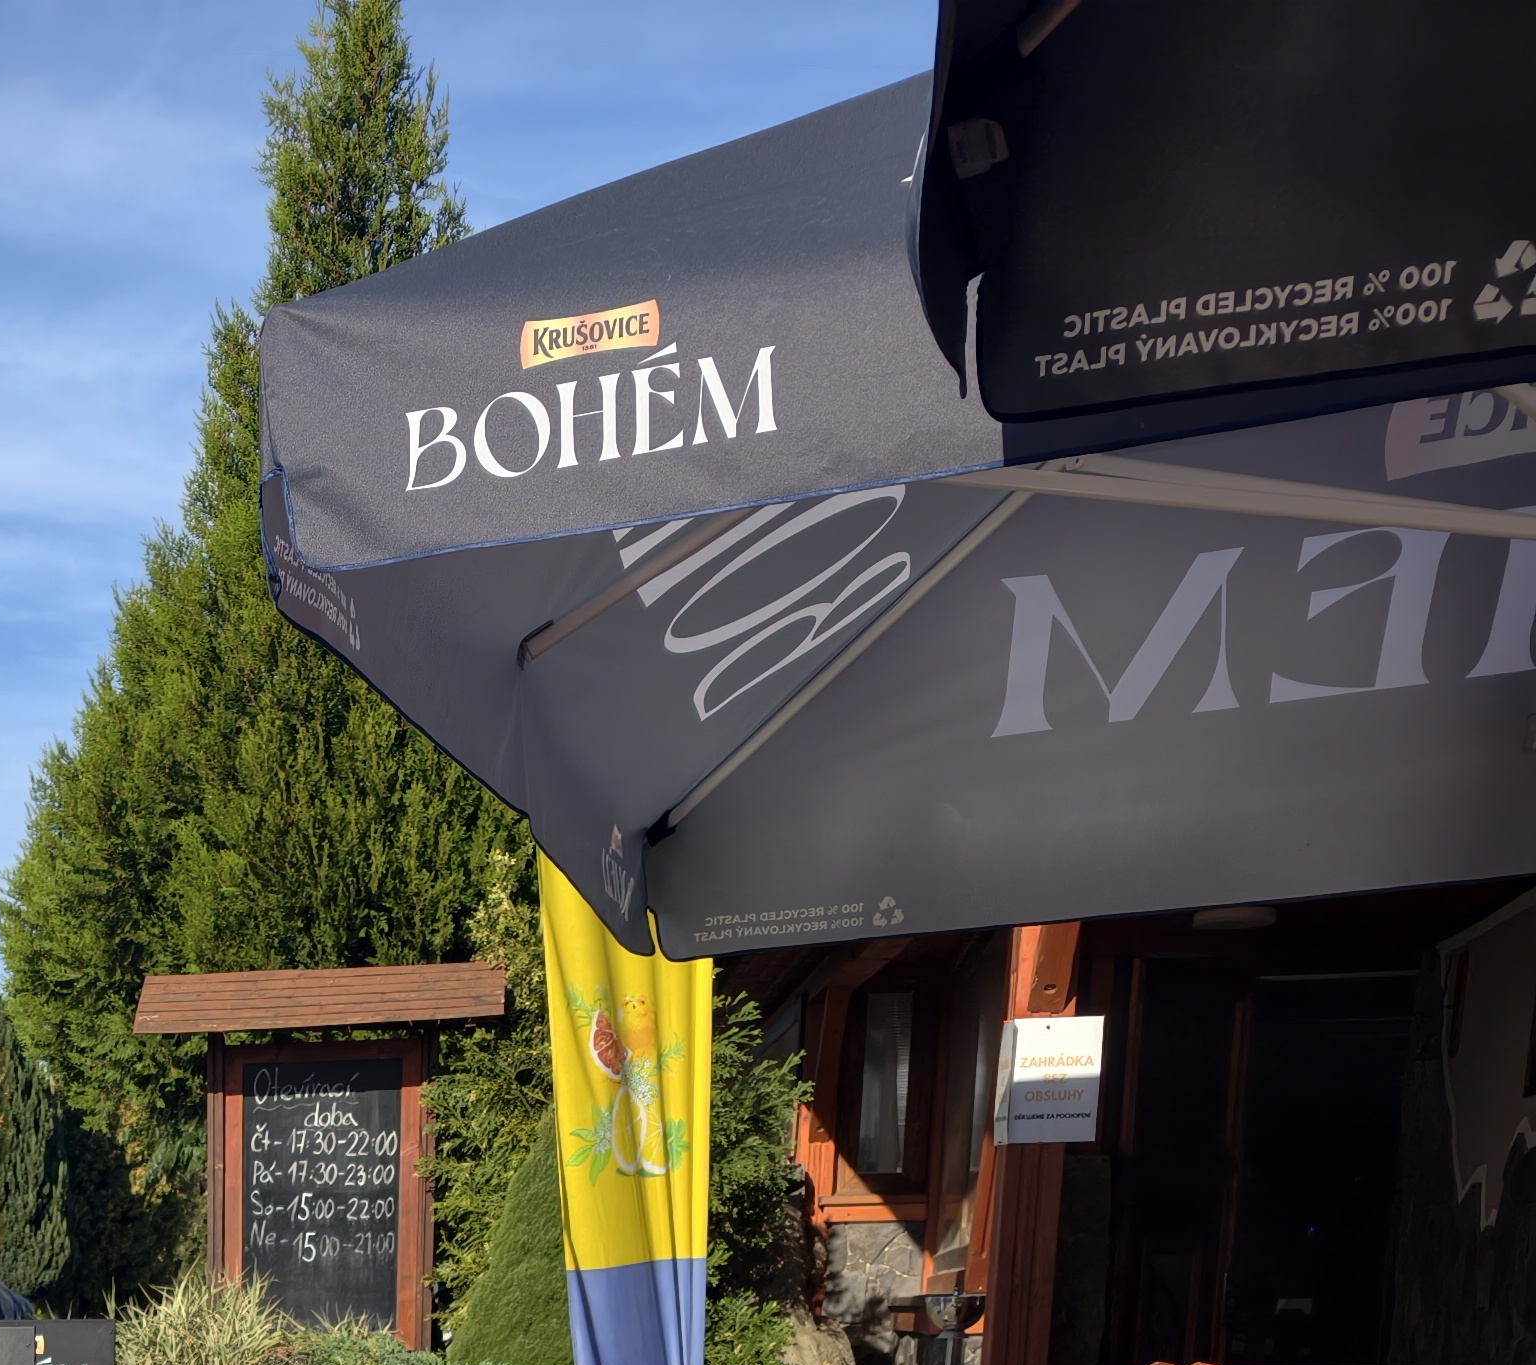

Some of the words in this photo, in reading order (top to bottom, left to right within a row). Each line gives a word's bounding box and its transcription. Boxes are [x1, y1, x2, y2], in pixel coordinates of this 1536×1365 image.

[404, 340, 778, 491] BOHÉM
[1019, 1052, 1094, 1068] ZAHRÁDKA
[1043, 1073, 1068, 1084] BEZ
[1024, 1089, 1085, 1102] OBSLUHY
[303, 1101, 359, 1128] doba
